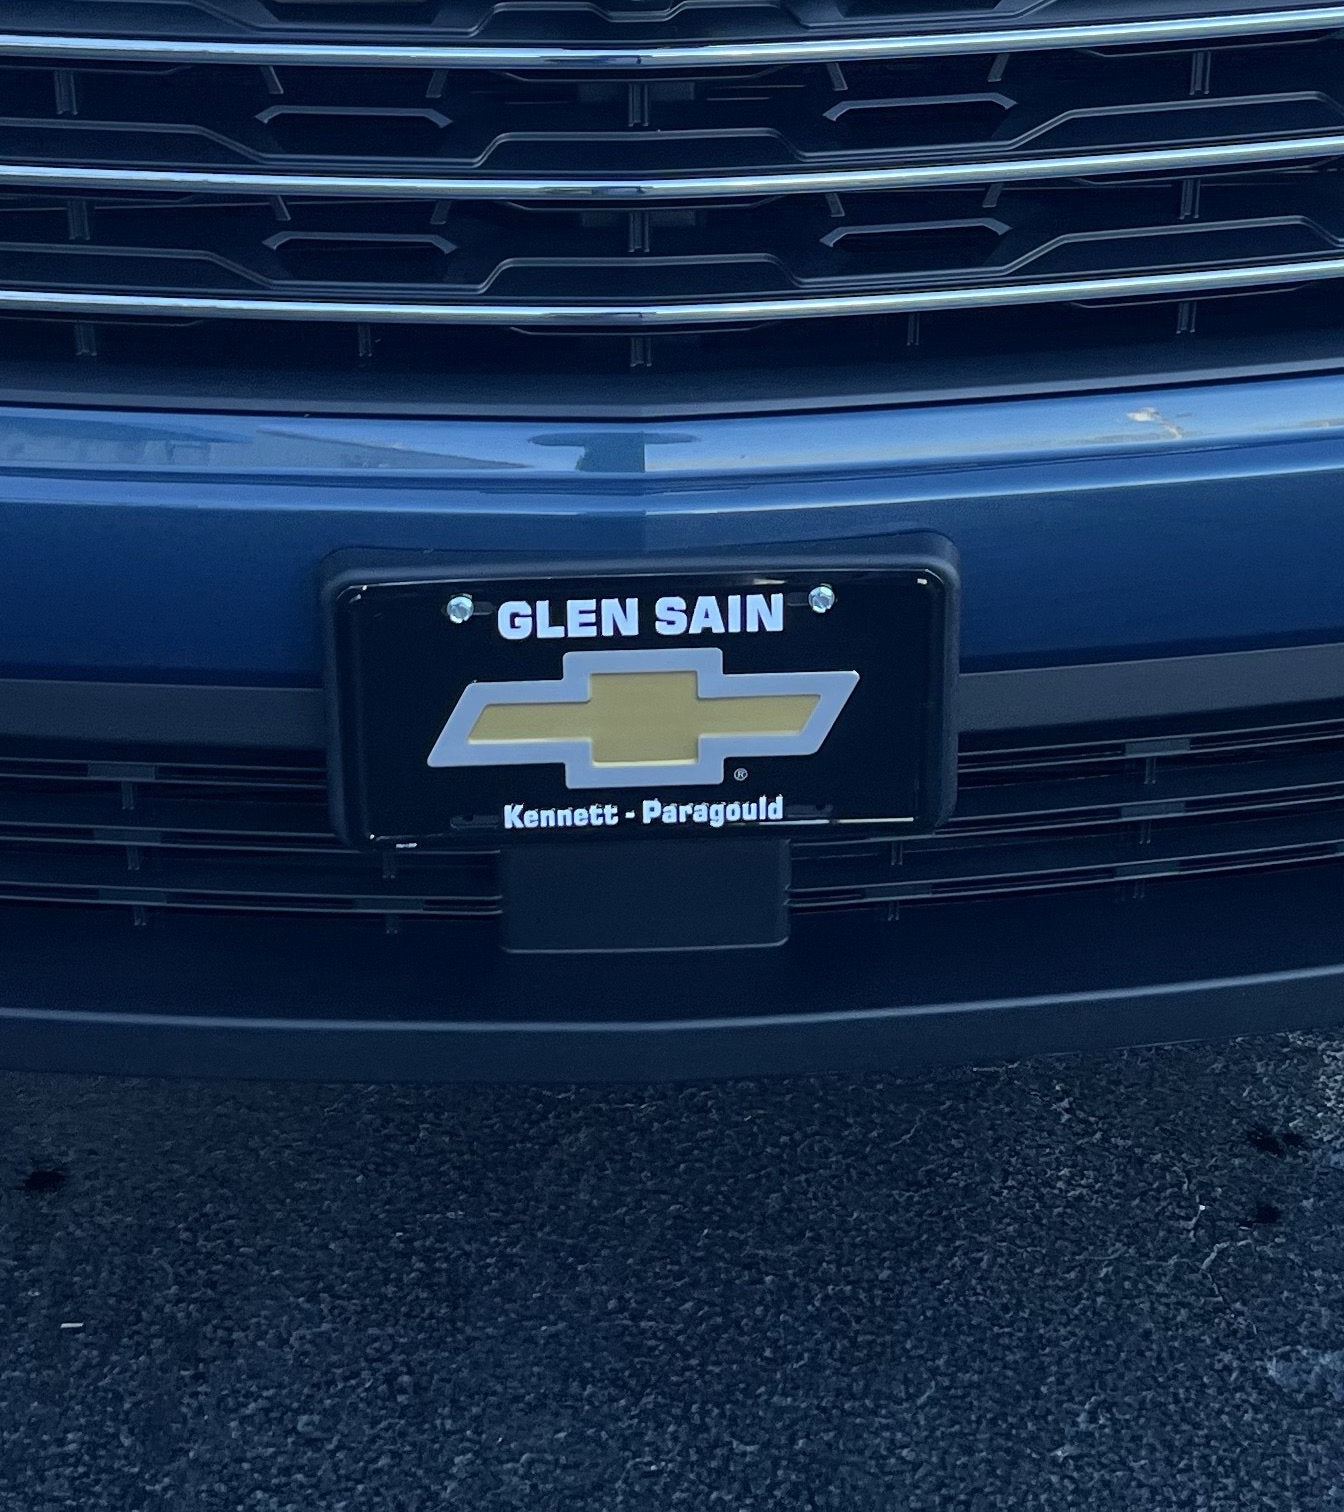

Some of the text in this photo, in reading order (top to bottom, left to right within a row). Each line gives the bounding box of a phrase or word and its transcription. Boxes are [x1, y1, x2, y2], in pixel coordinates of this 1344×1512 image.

[497, 593, 784, 640] GLEN SAIN
[504, 802, 619, 829] Kennett
[642, 794, 784, 828] Paragould
